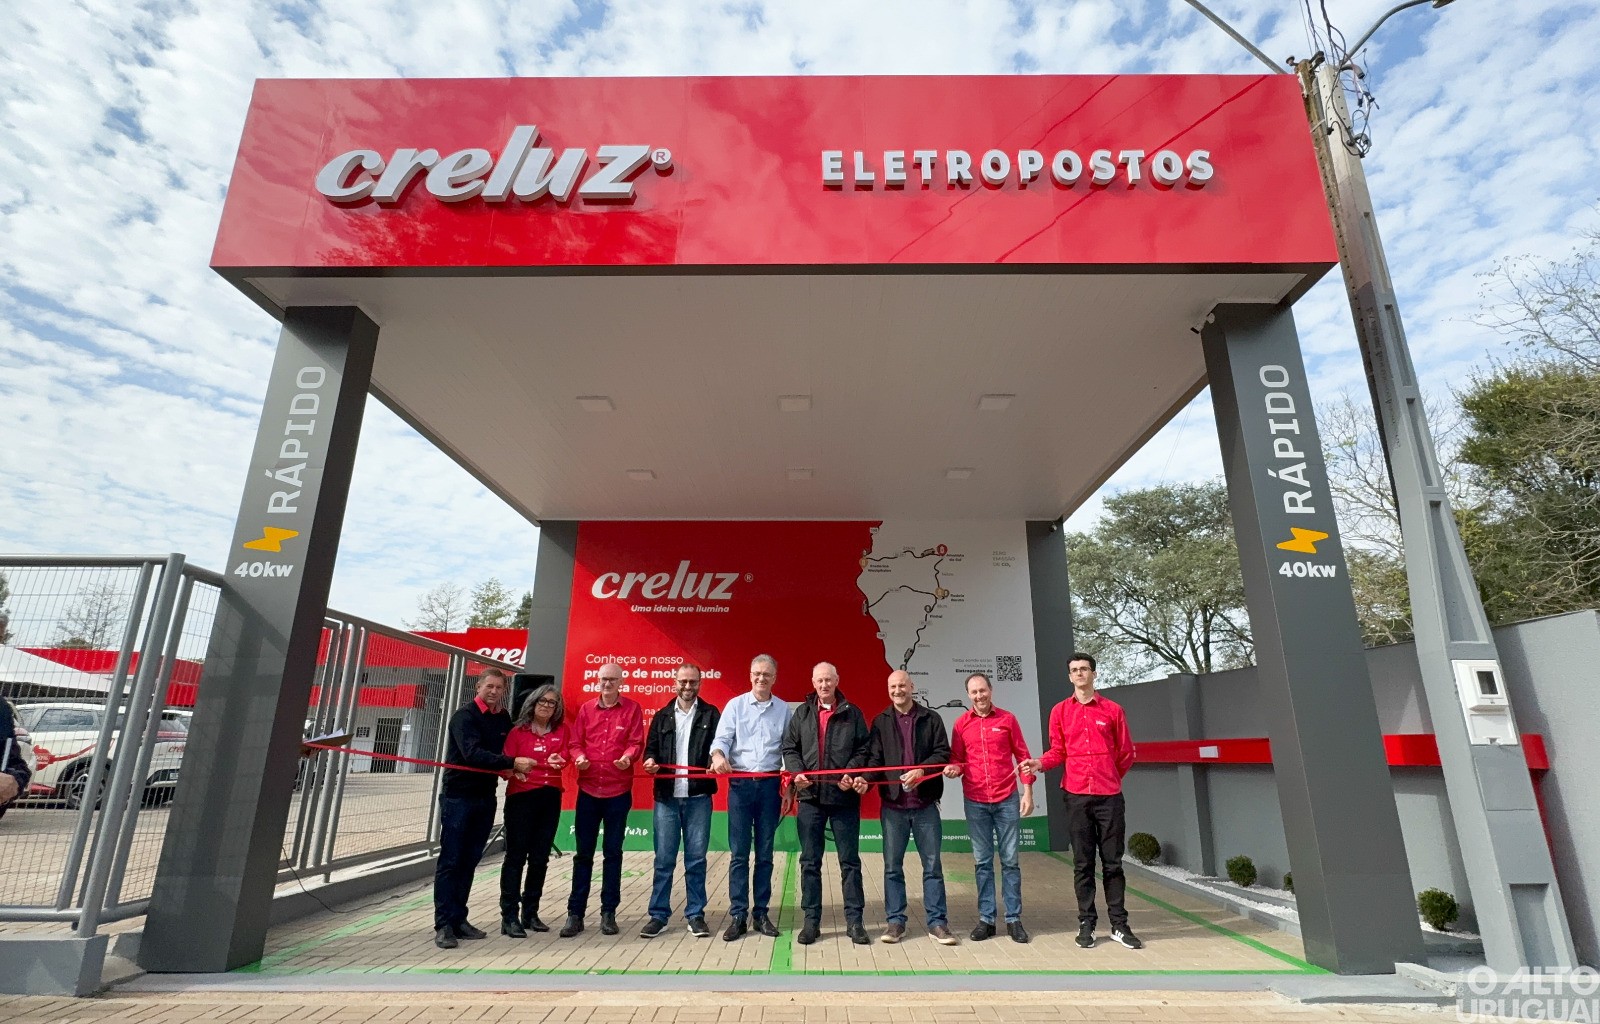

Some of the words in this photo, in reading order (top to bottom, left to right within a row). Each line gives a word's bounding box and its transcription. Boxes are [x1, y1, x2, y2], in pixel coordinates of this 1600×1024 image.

[315, 125, 651, 203] creluz
[821, 149, 1214, 186] ELETROPOSTOS
[264, 366, 326, 514] RÁPIDO
[1267, 364, 1316, 514] RÁPIDO
[234, 561, 294, 578] 40kw
[1278, 561, 1337, 578] 40kw
[591, 560, 740, 600] creluz
[631, 604, 652, 613] Uma
[653, 604, 675, 613] ideia
[677, 605, 694, 614] que
[695, 604, 730, 613] ilumina
[585, 653, 637, 666] Conheça
[650, 656, 684, 664] nosso
[632, 668, 649, 679] de
[651, 668, 722, 679] mobade
[582, 681, 631, 693] eléca
[633, 682, 679, 695] regiona
